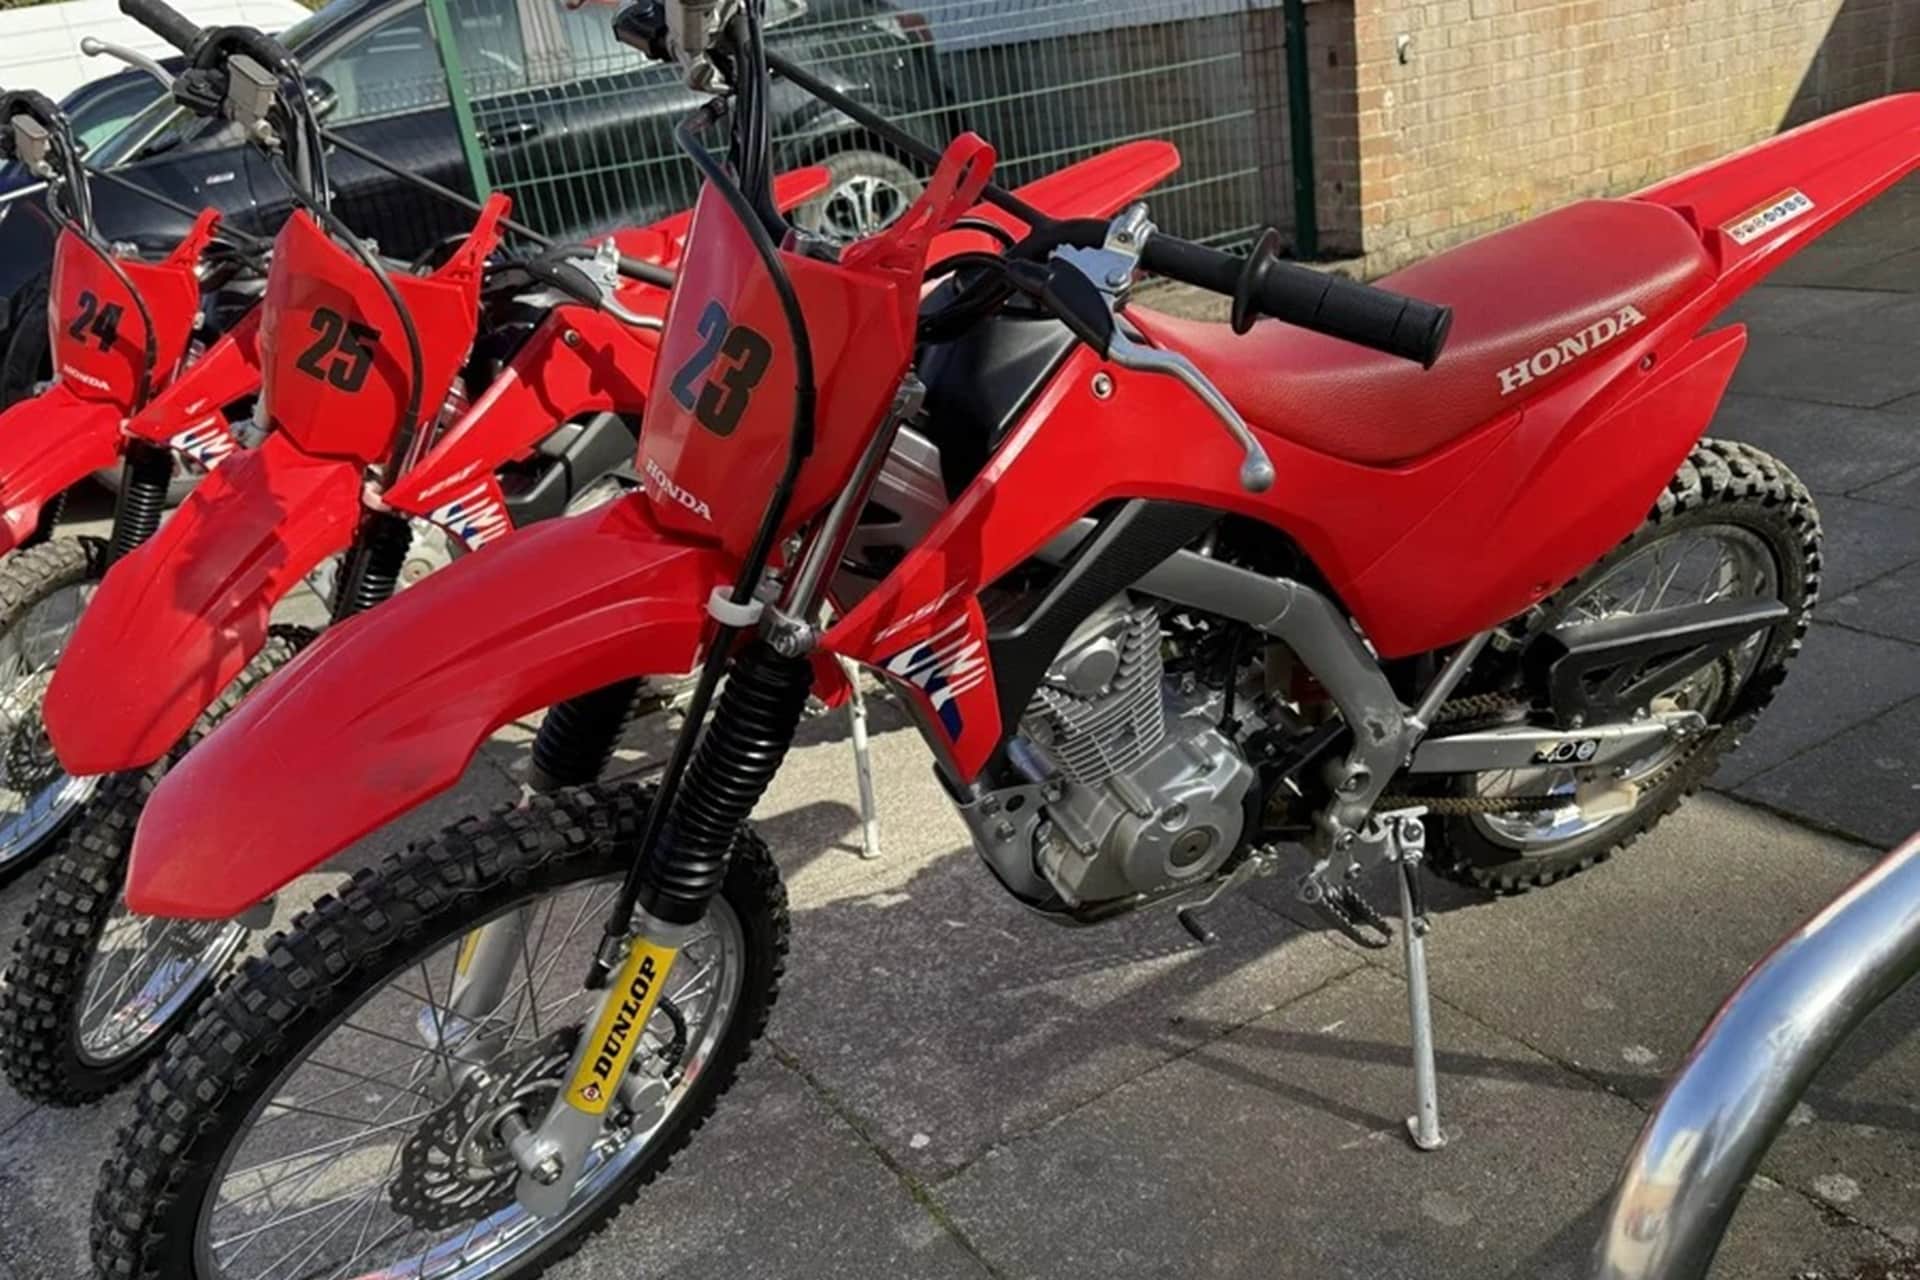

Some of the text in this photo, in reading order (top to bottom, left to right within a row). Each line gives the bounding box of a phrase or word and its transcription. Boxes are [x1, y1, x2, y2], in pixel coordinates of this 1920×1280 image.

[68, 289, 124, 353] 24
[295, 305, 383, 394] 25
[1496, 304, 1646, 396] HONDA
[669, 298, 773, 437] 23
[645, 458, 713, 522] HONDA
[592, 955, 657, 1081] DUNLOP
